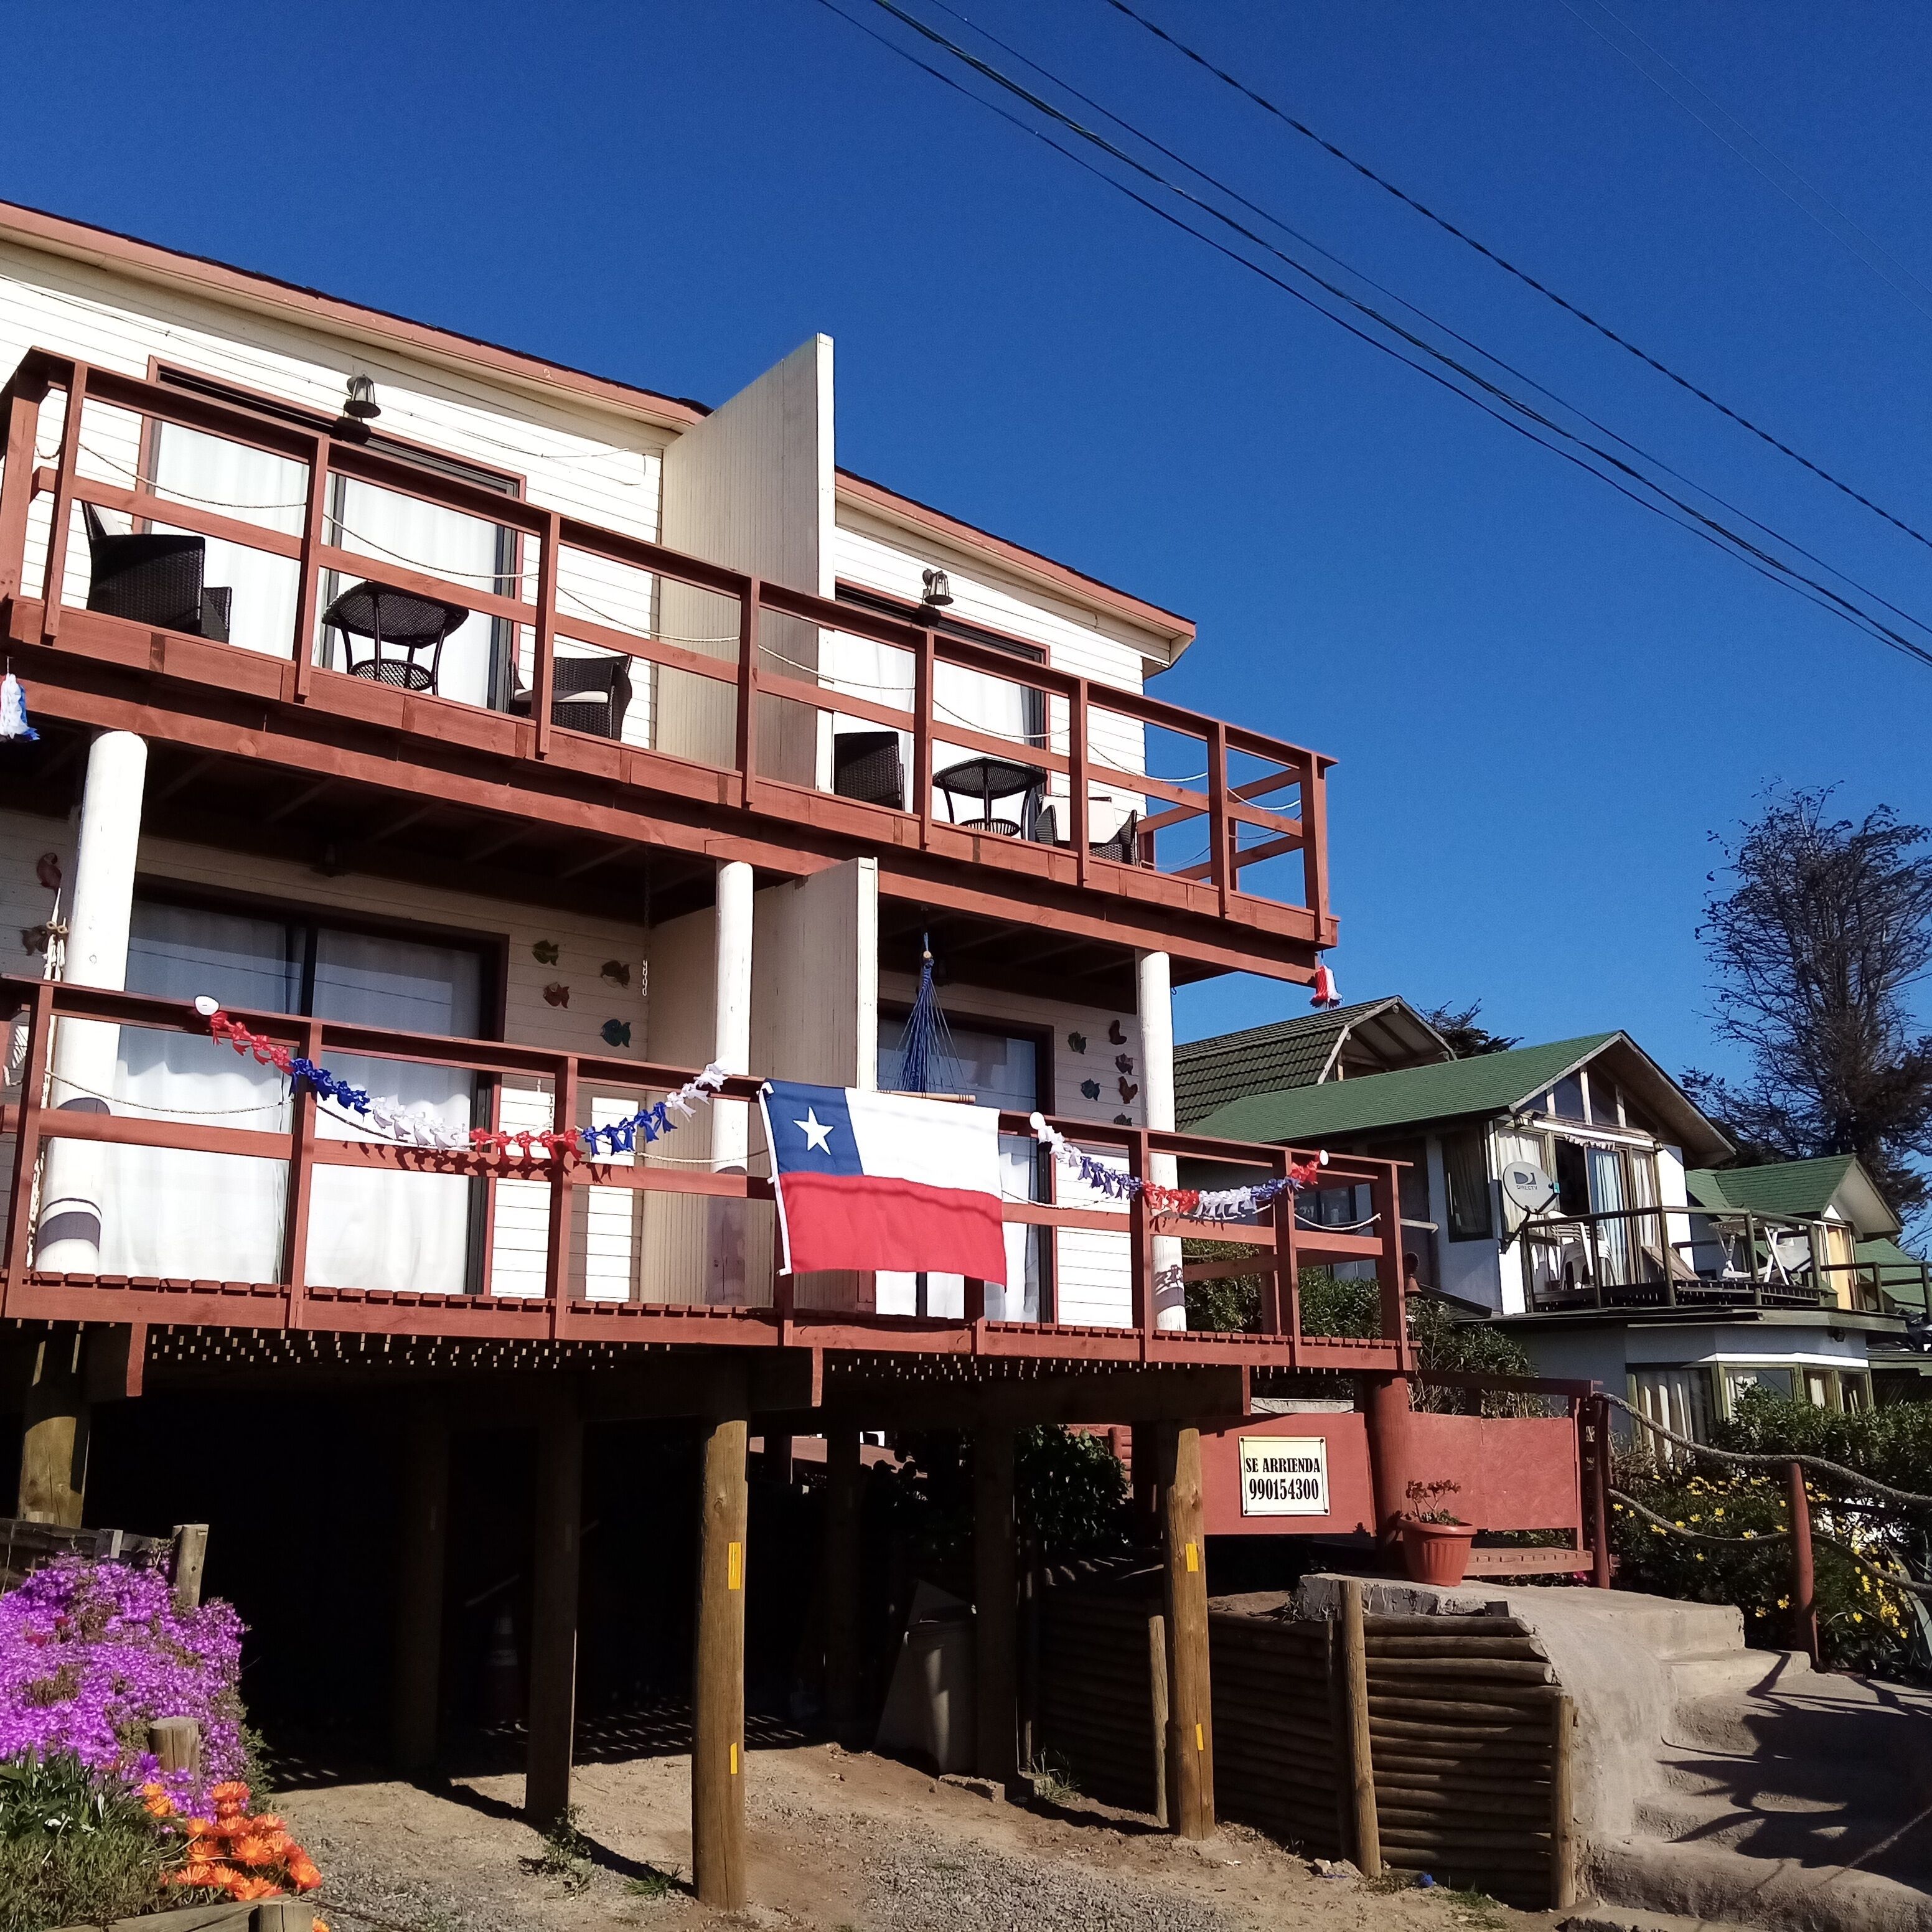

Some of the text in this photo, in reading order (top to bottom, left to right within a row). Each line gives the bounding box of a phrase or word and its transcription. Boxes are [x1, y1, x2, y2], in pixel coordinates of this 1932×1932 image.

[1245, 1458, 1320, 1473] SE ARRIENDA
[1249, 1478, 1319, 1500] 990154300
